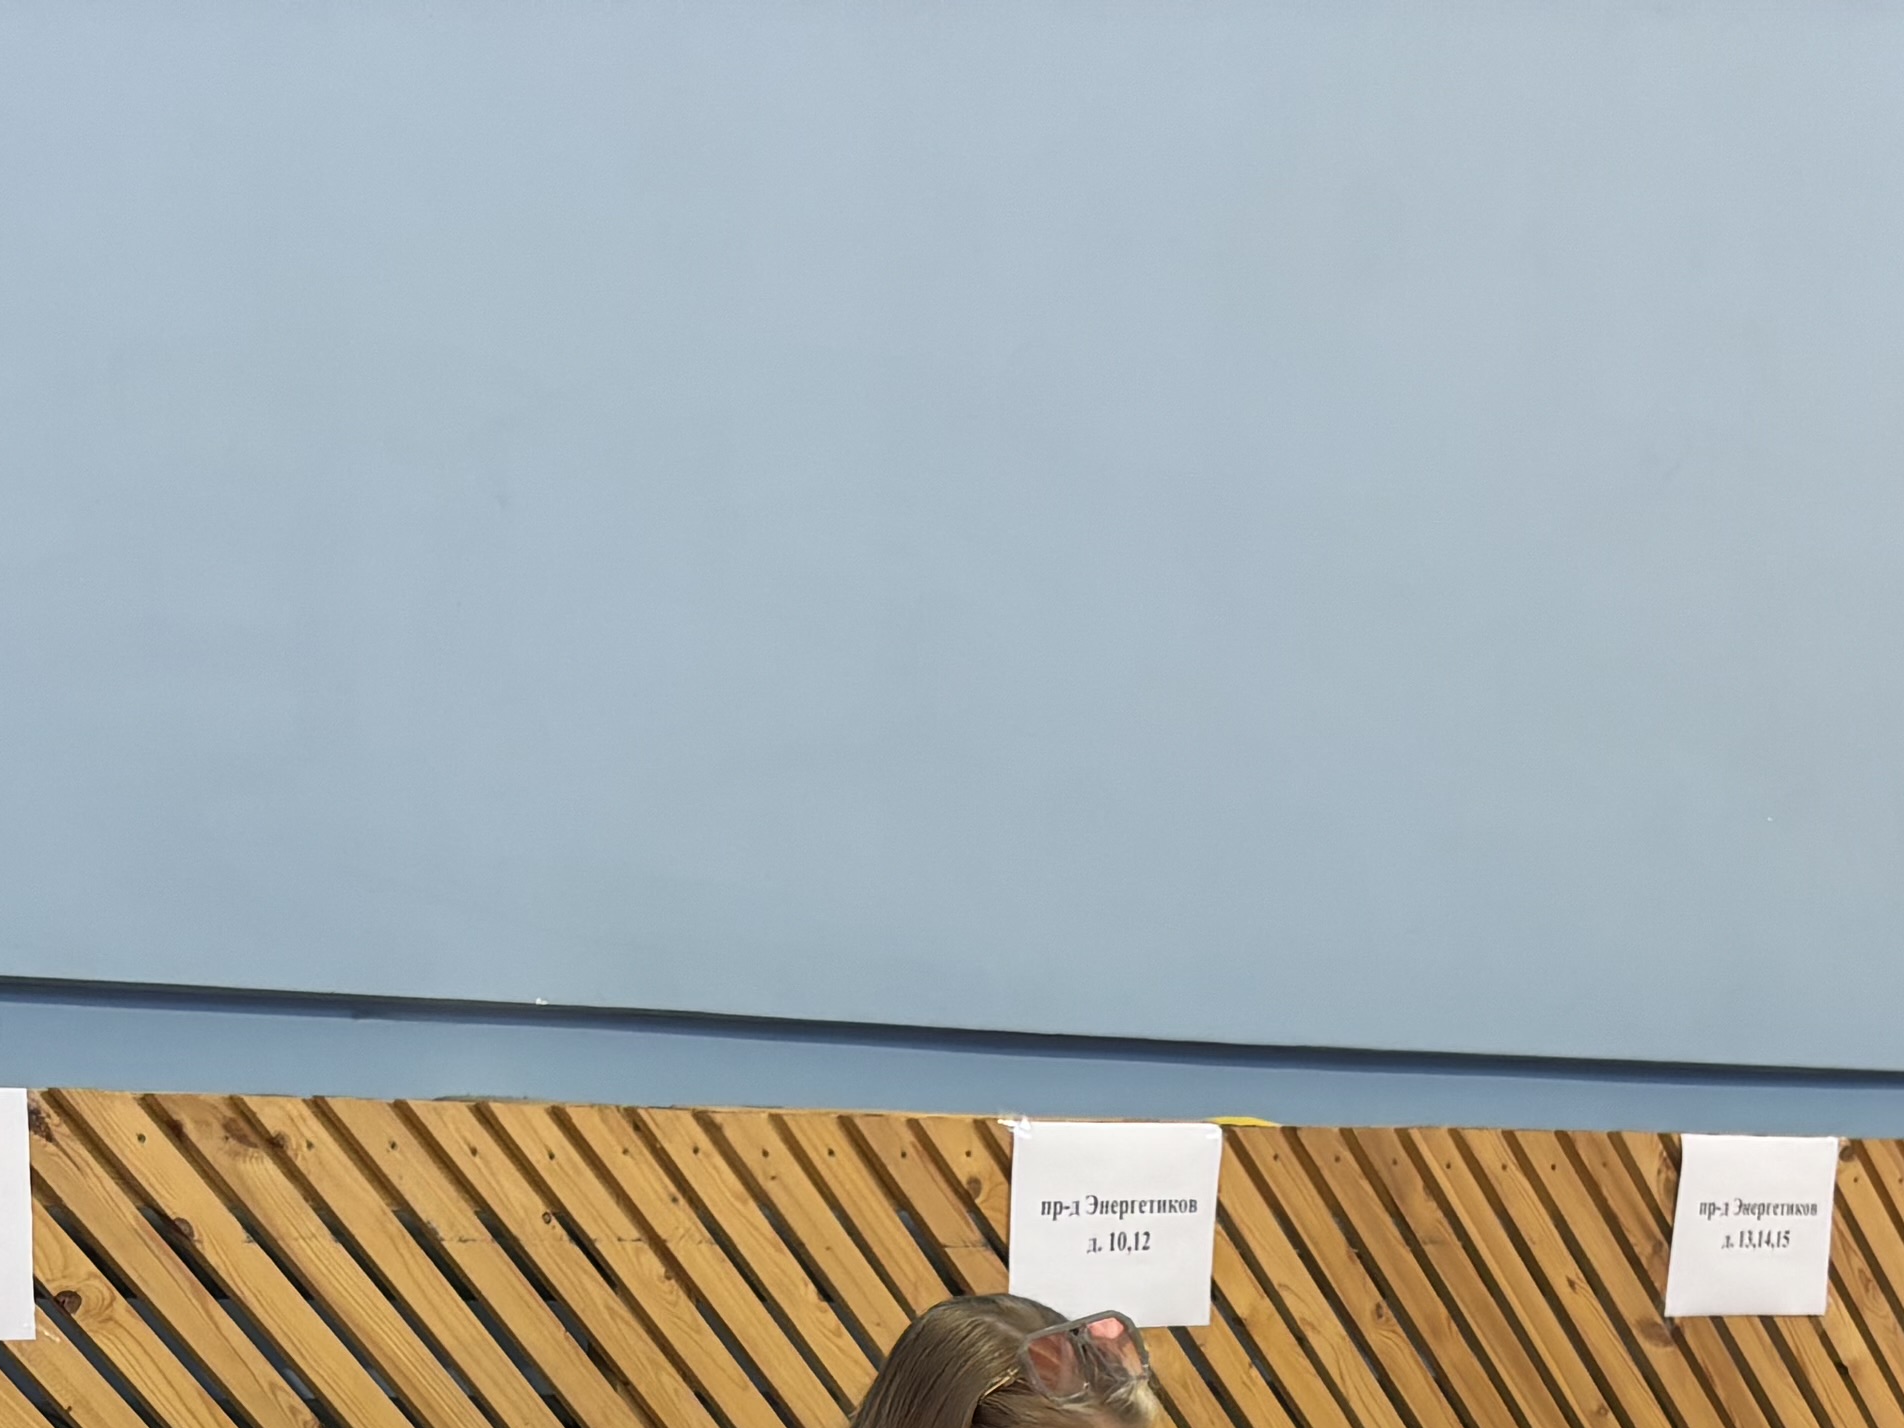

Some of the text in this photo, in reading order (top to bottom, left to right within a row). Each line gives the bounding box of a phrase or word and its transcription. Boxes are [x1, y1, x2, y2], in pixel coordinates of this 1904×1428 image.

[1040, 1194, 1198, 1222] пр-д Энергетиков
[1698, 1197, 1818, 1221] пр-д Энергетиков
[1086, 1230, 1151, 1254] д. 10,12
[1739, 1229, 1791, 1250] 13,14,15
